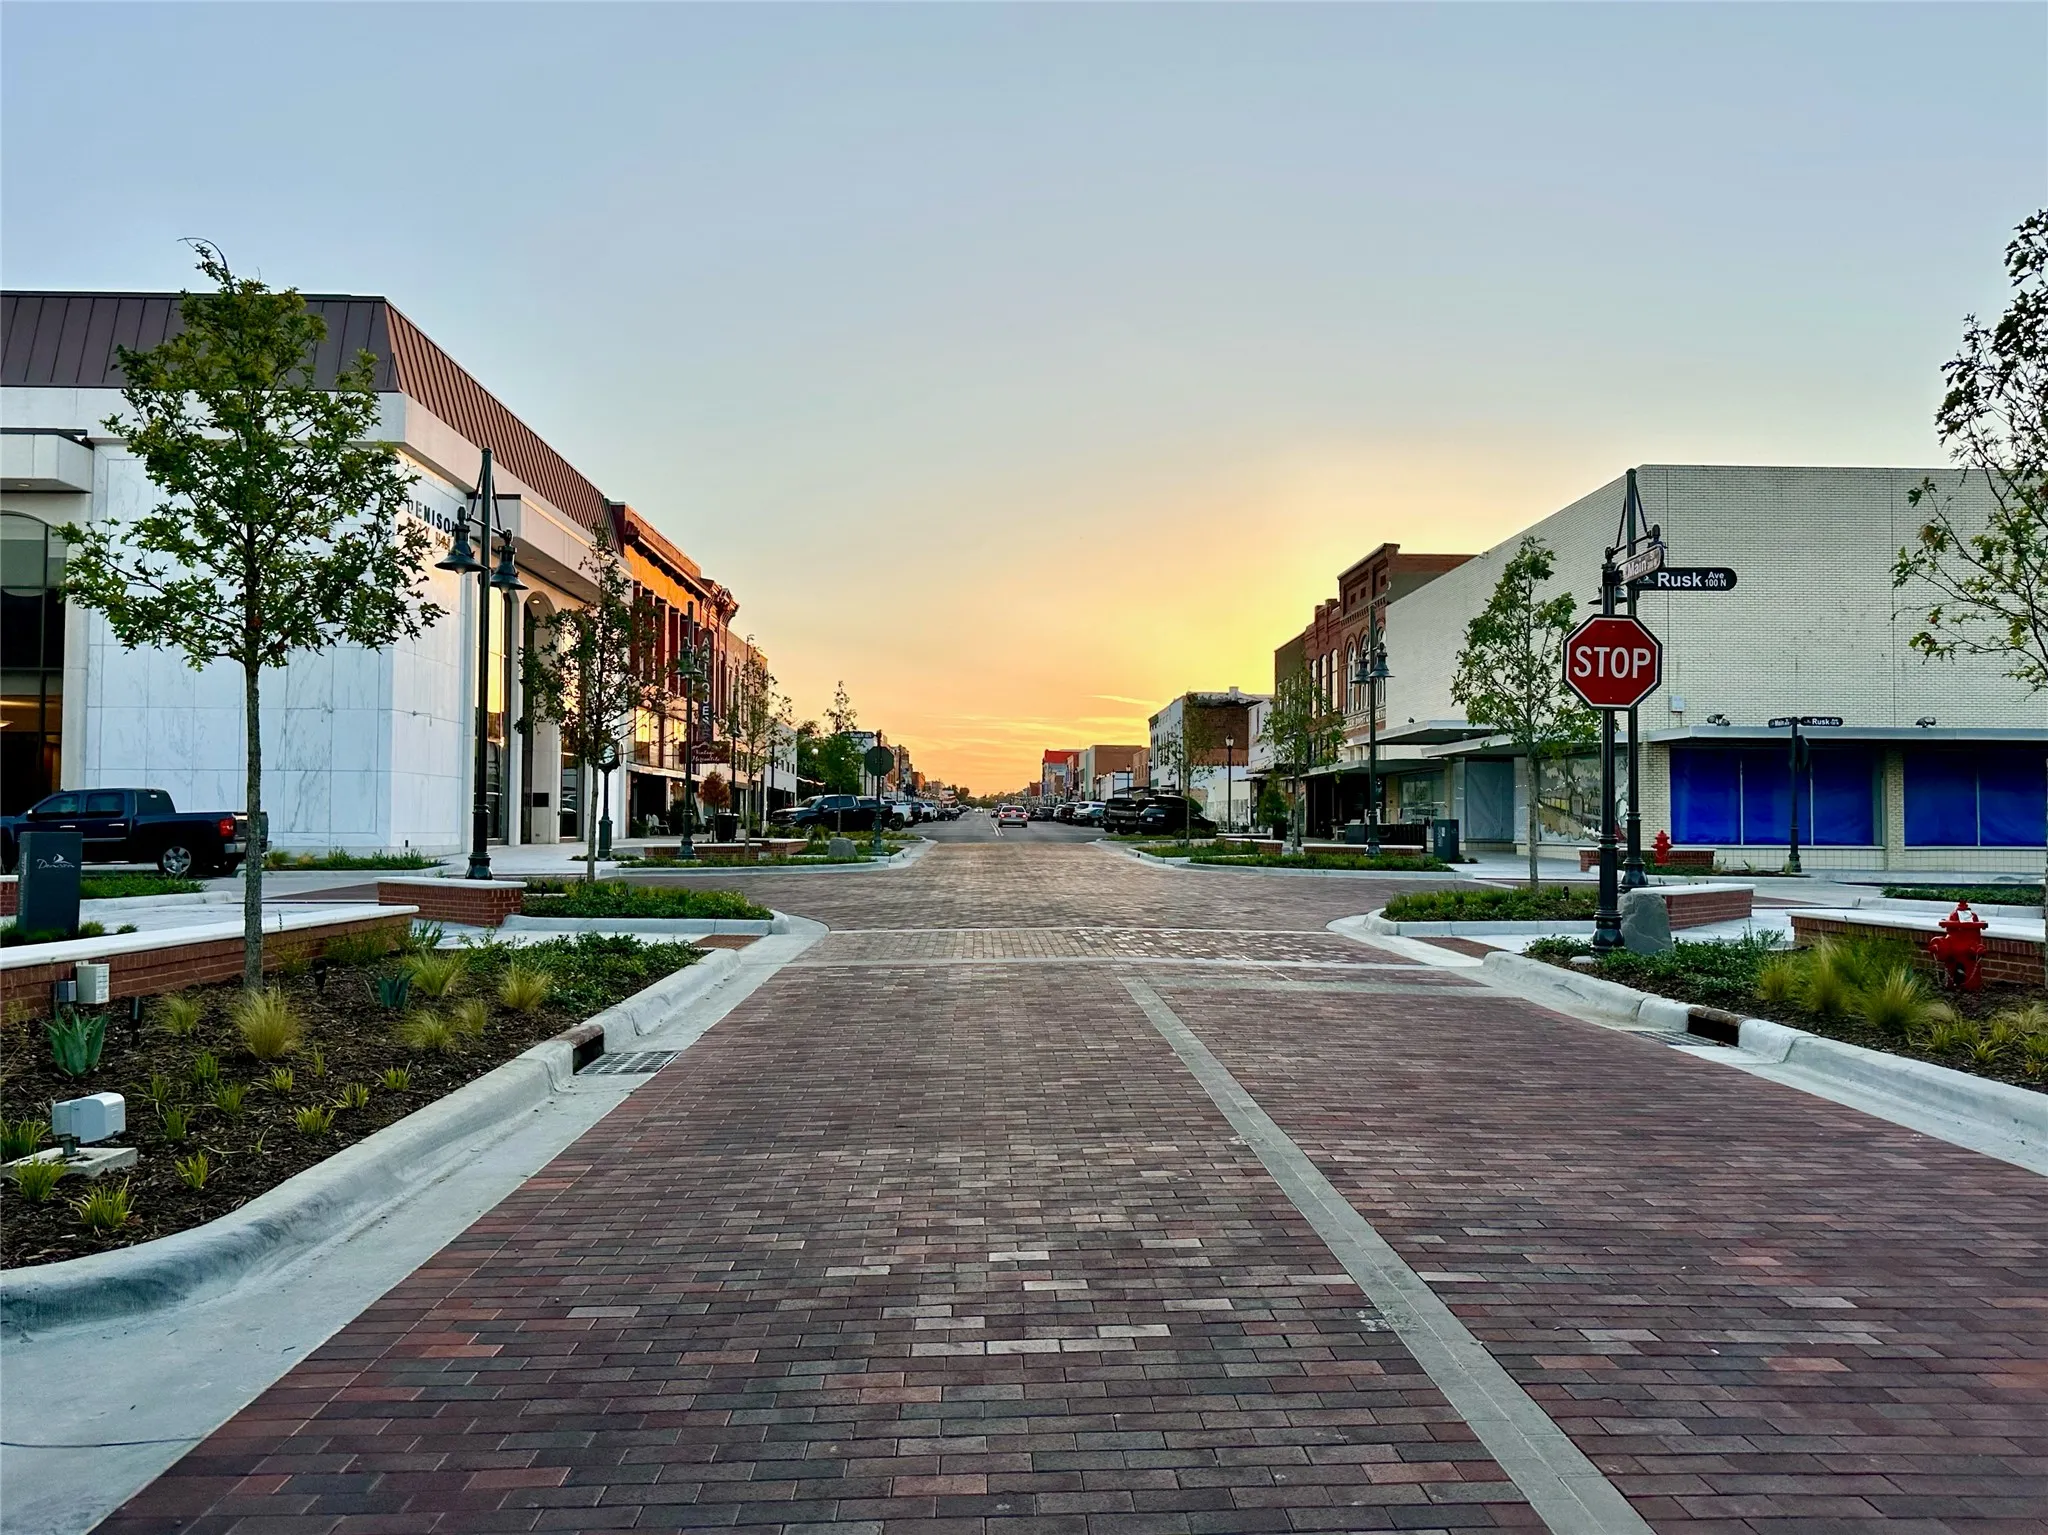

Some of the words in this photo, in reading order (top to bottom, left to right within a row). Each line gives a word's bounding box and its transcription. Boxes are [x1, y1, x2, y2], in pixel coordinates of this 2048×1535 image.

[1627, 558, 1647, 578] Main
[1708, 572, 1724, 580] Ave
[1657, 572, 1702, 587] Rusk
[1573, 646, 1651, 679] STOP
[702, 637, 710, 726] ANTIQUES
[1812, 718, 1830, 726] Rusk
